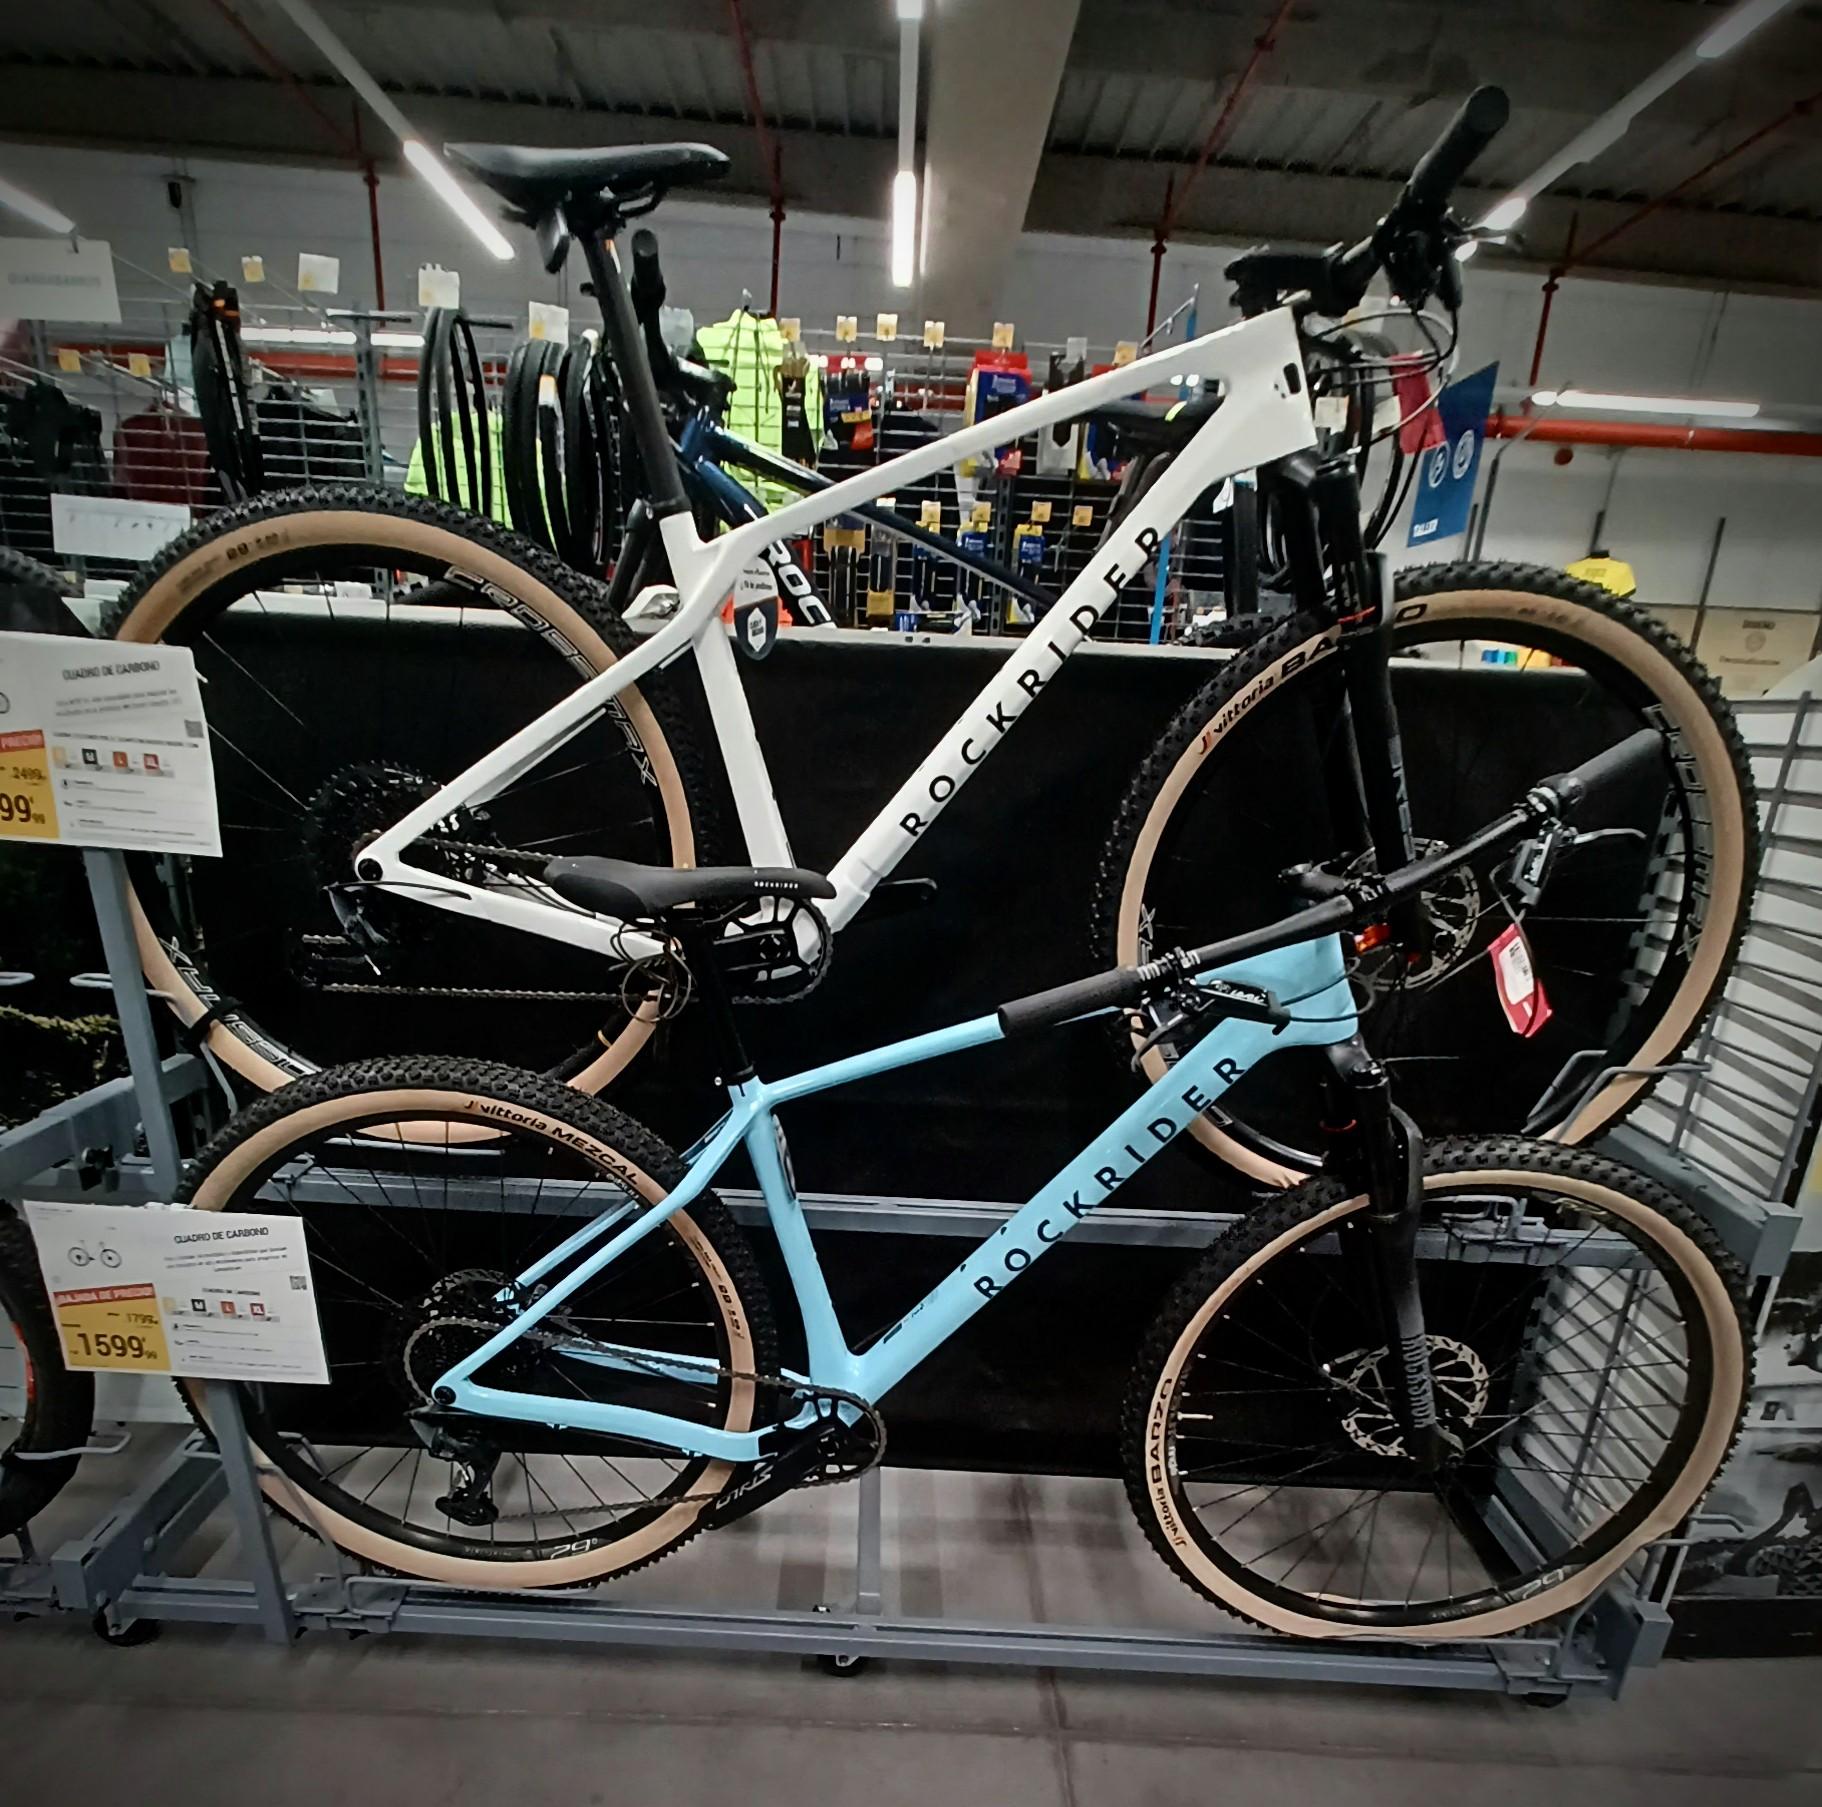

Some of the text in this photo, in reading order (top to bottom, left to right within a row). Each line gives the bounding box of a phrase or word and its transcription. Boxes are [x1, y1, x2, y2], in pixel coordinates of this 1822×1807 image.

[900, 527, 1159, 837] ROCKRIDER
[1214, 673, 1274, 735] vittoria
[480, 1104, 639, 1185] vittoria MEZCAL
[974, 1058, 1246, 1300] ROCKRIDER
[212, 1231, 225, 1241] DE
[226, 1226, 269, 1239] CARBONO
[1155, 1487, 1179, 1537] vittoria
